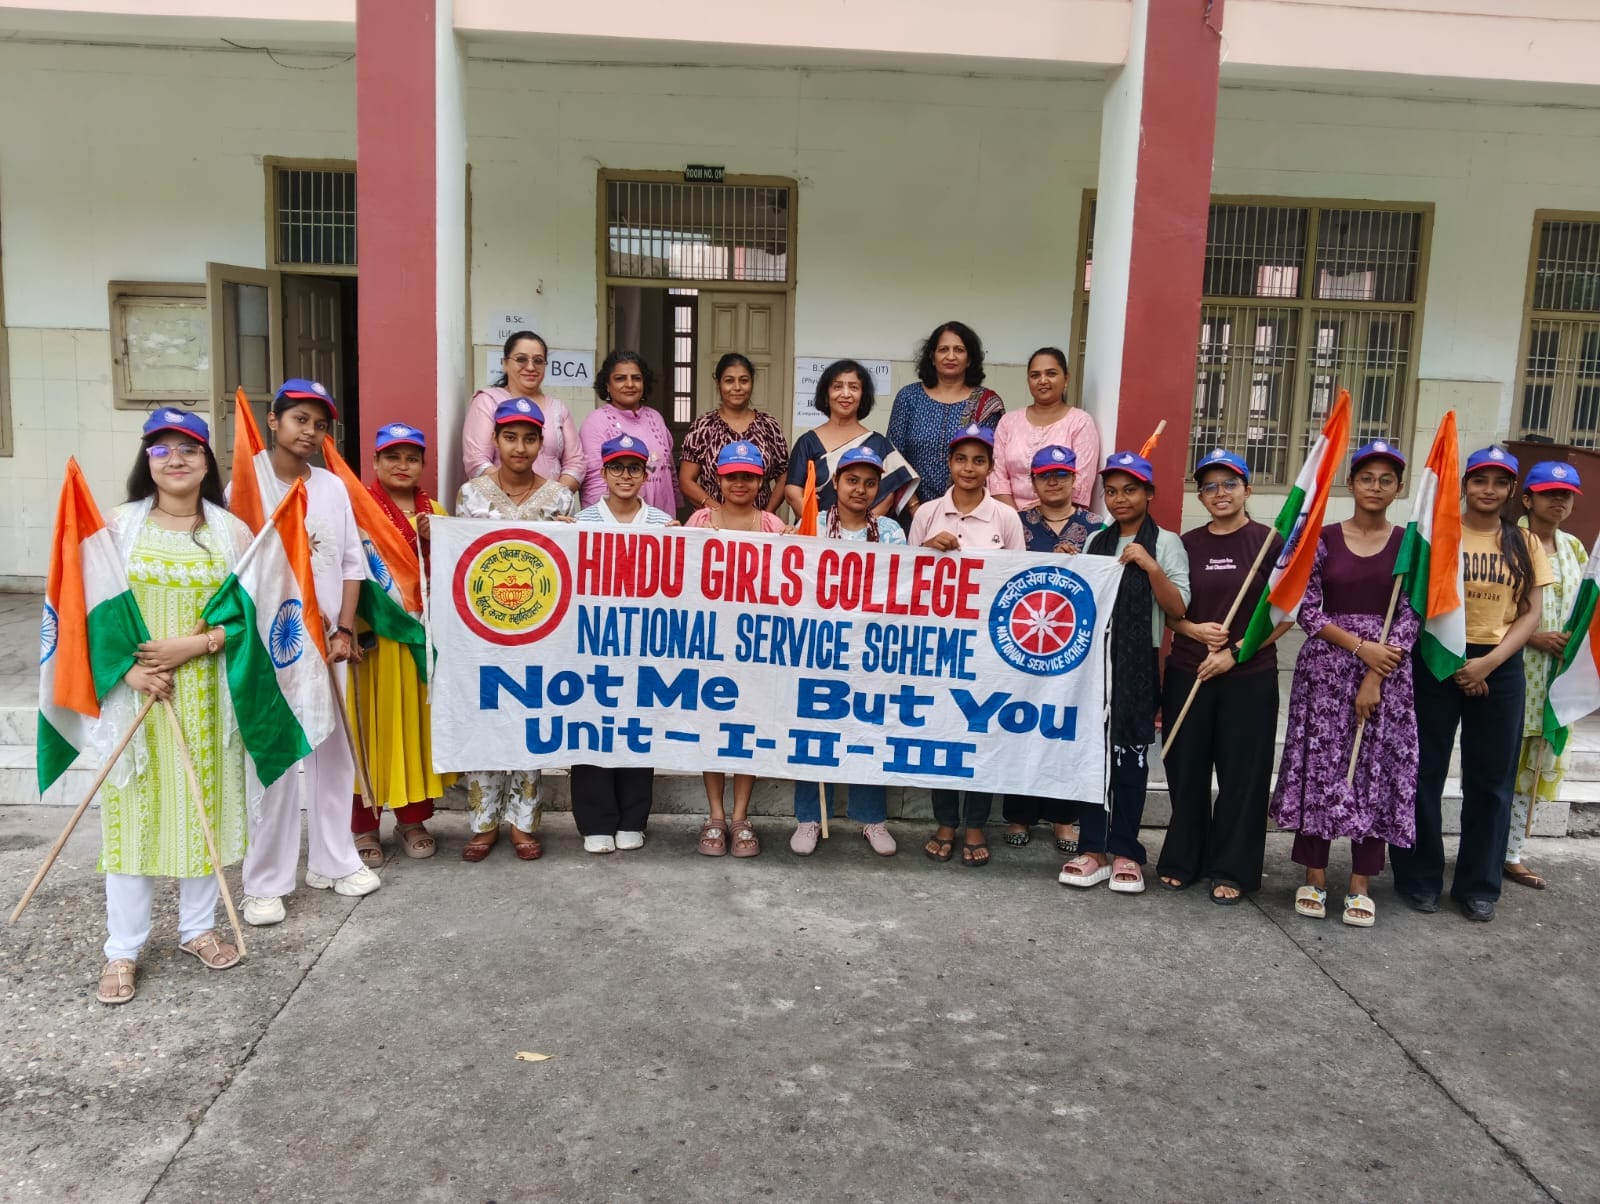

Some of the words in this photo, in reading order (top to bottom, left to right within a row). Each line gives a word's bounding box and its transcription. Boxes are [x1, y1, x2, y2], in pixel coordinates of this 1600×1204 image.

[686, 168, 703, 179] ROOM
[704, 169, 714, 179] NO.
[551, 361, 588, 378] BCA
[876, 366, 889, 375] (IT)
[577, 531, 685, 598] HINDU
[701, 538, 804, 606] GIRLS
[816, 549, 984, 619] COLLEGE
[1026, 571, 1047, 586] सेवा
[1048, 568, 1084, 595] योजना
[578, 605, 724, 661] NATIONAL
[735, 613, 852, 671] SERVICE
[862, 623, 977, 680] SCHEME
[997, 626, 1026, 666] NATIONAL
[1027, 656, 1064, 671] SERVICE
[1064, 629, 1091, 664] SCHEME
[480, 664, 624, 710] Not
[637, 665, 739, 711] Me
[797, 677, 934, 727] But
[949, 688, 1078, 741] You
